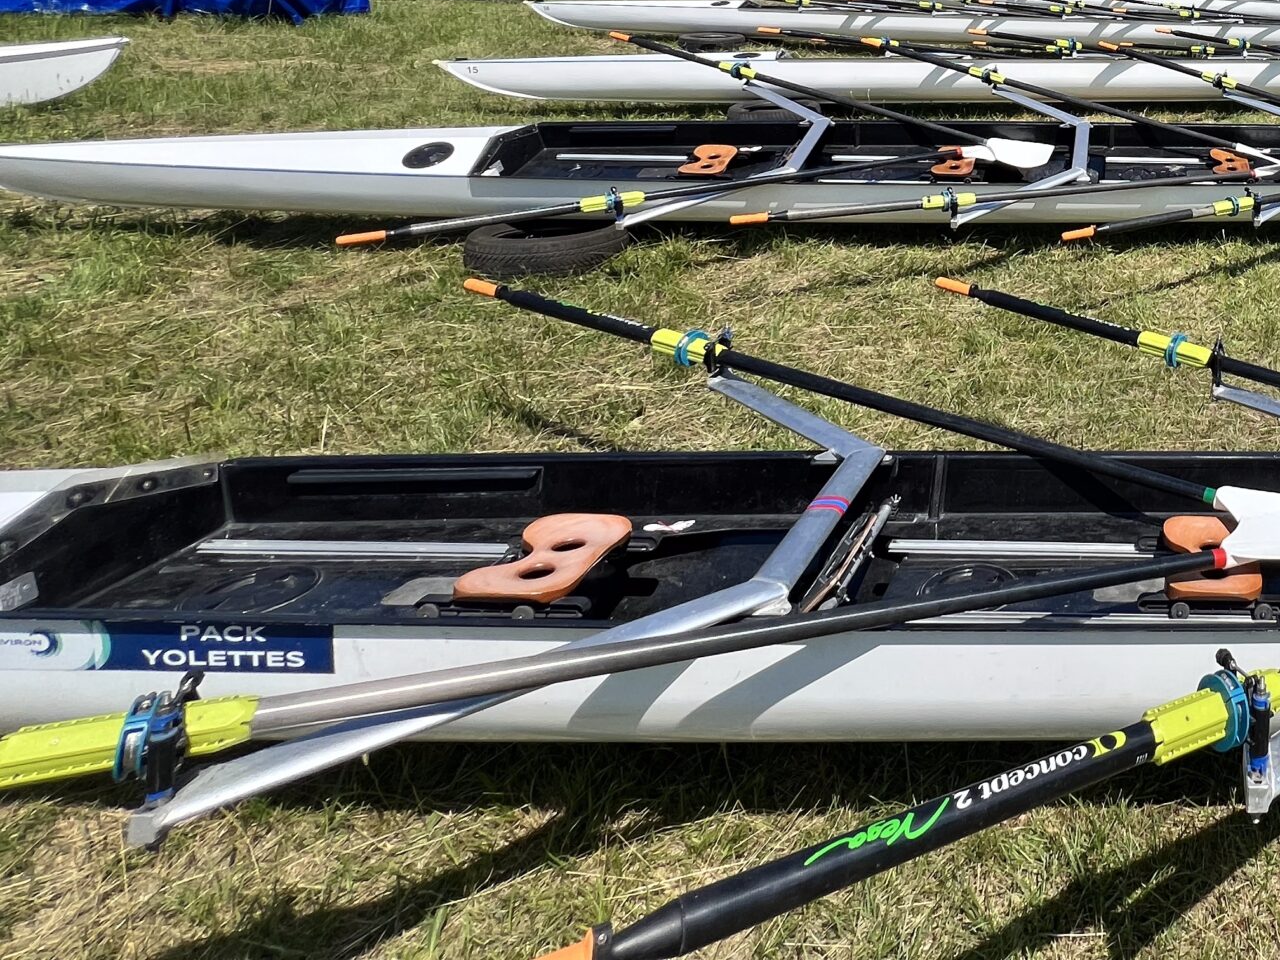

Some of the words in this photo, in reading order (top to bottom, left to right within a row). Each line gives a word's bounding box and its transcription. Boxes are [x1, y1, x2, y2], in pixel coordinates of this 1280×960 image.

[467, 66, 479, 74] 15
[180, 625, 267, 642] PACK
[141, 649, 306, 668] YOLETTES
[979, 744, 1088, 800] concept
[954, 790, 973, 810] 2
